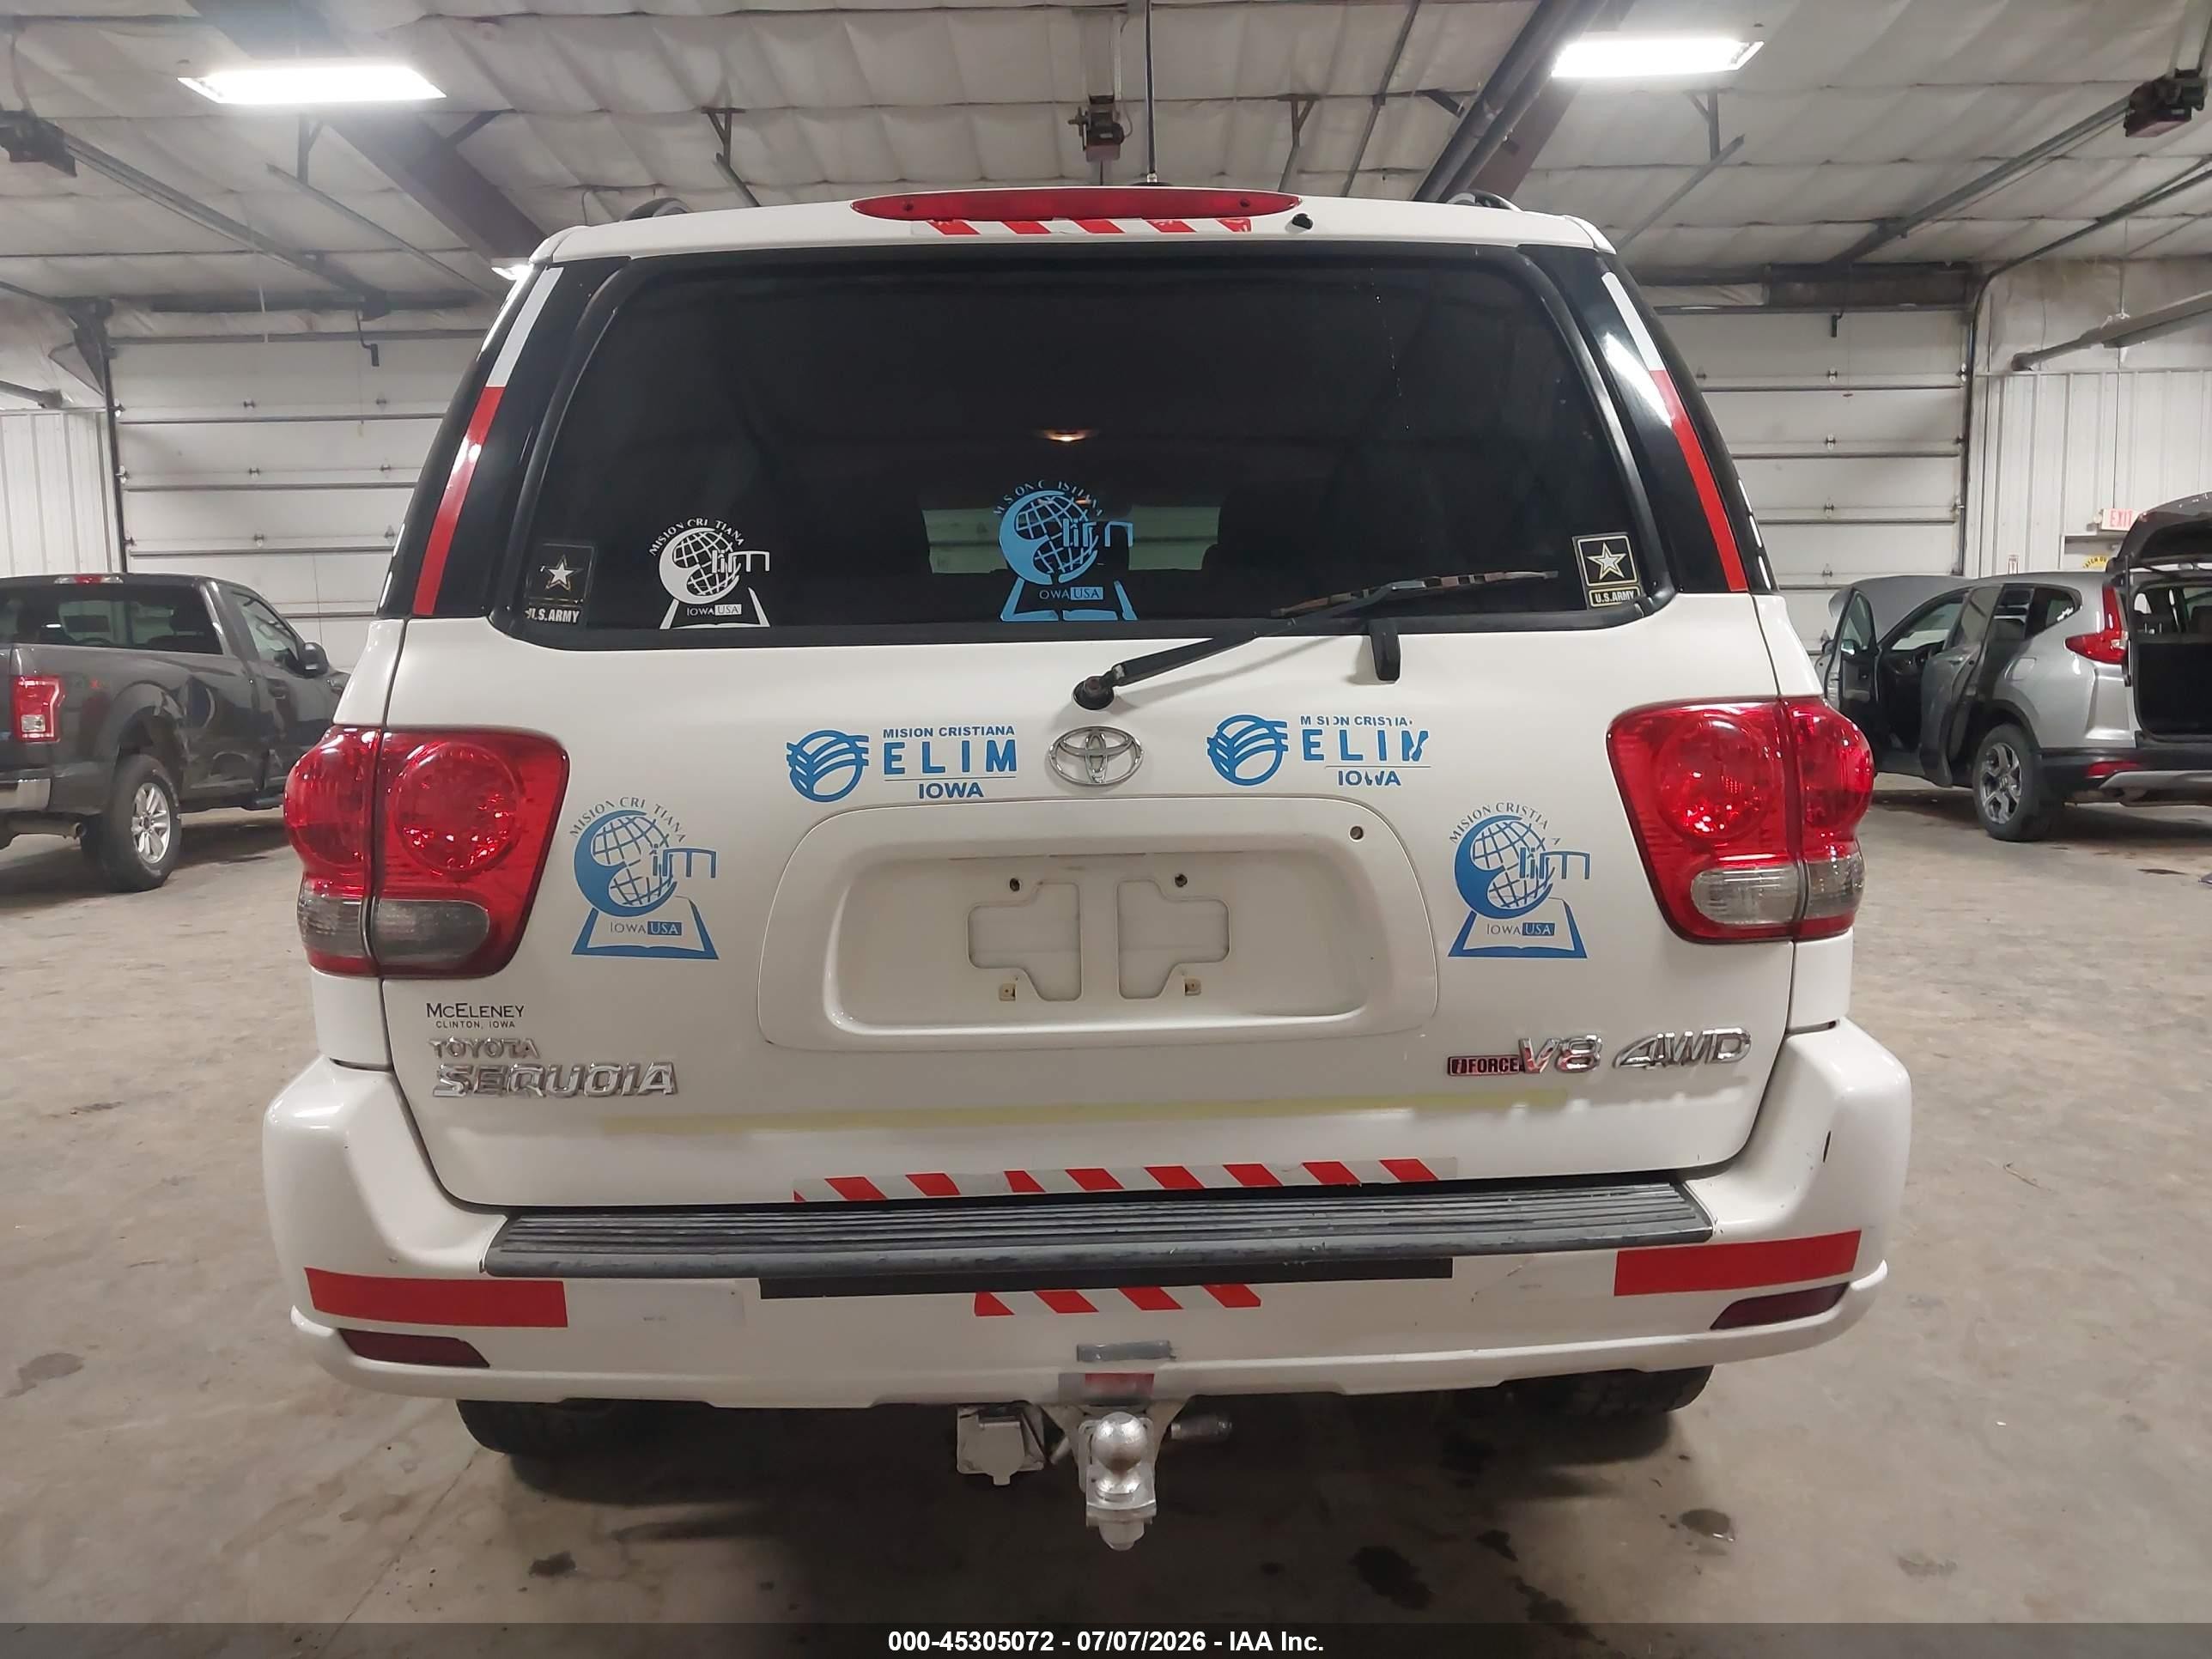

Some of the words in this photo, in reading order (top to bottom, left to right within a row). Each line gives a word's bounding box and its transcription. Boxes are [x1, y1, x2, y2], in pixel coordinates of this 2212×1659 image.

[2110, 509, 2133, 527] EXIT
[687, 518, 744, 546] CRITIANA
[1039, 589, 1070, 600] OWA
[1073, 589, 1100, 599] USA
[687, 606, 714, 617] IOWA
[717, 605, 740, 616] USA
[883, 727, 933, 738] MISION
[939, 726, 1015, 737] CRISTIANA
[884, 738, 1018, 775] ELIM
[1338, 770, 1401, 787] IOWA
[919, 782, 984, 799] IOWA
[1449, 804, 1492, 844] MISION
[610, 921, 647, 934] IOWA
[649, 921, 679, 935] USA
[1486, 923, 1522, 935] IOWA
[1524, 923, 1553, 935] USA
[435, 1020, 483, 1030] CLINTON,
[489, 1020, 516, 1029] IOWA
[428, 1036, 540, 1058] TOYOTA
[1518, 1034, 1602, 1073] V8
[1613, 1027, 1751, 1069] 4WD
[433, 1062, 678, 1097] SEQUOIA
